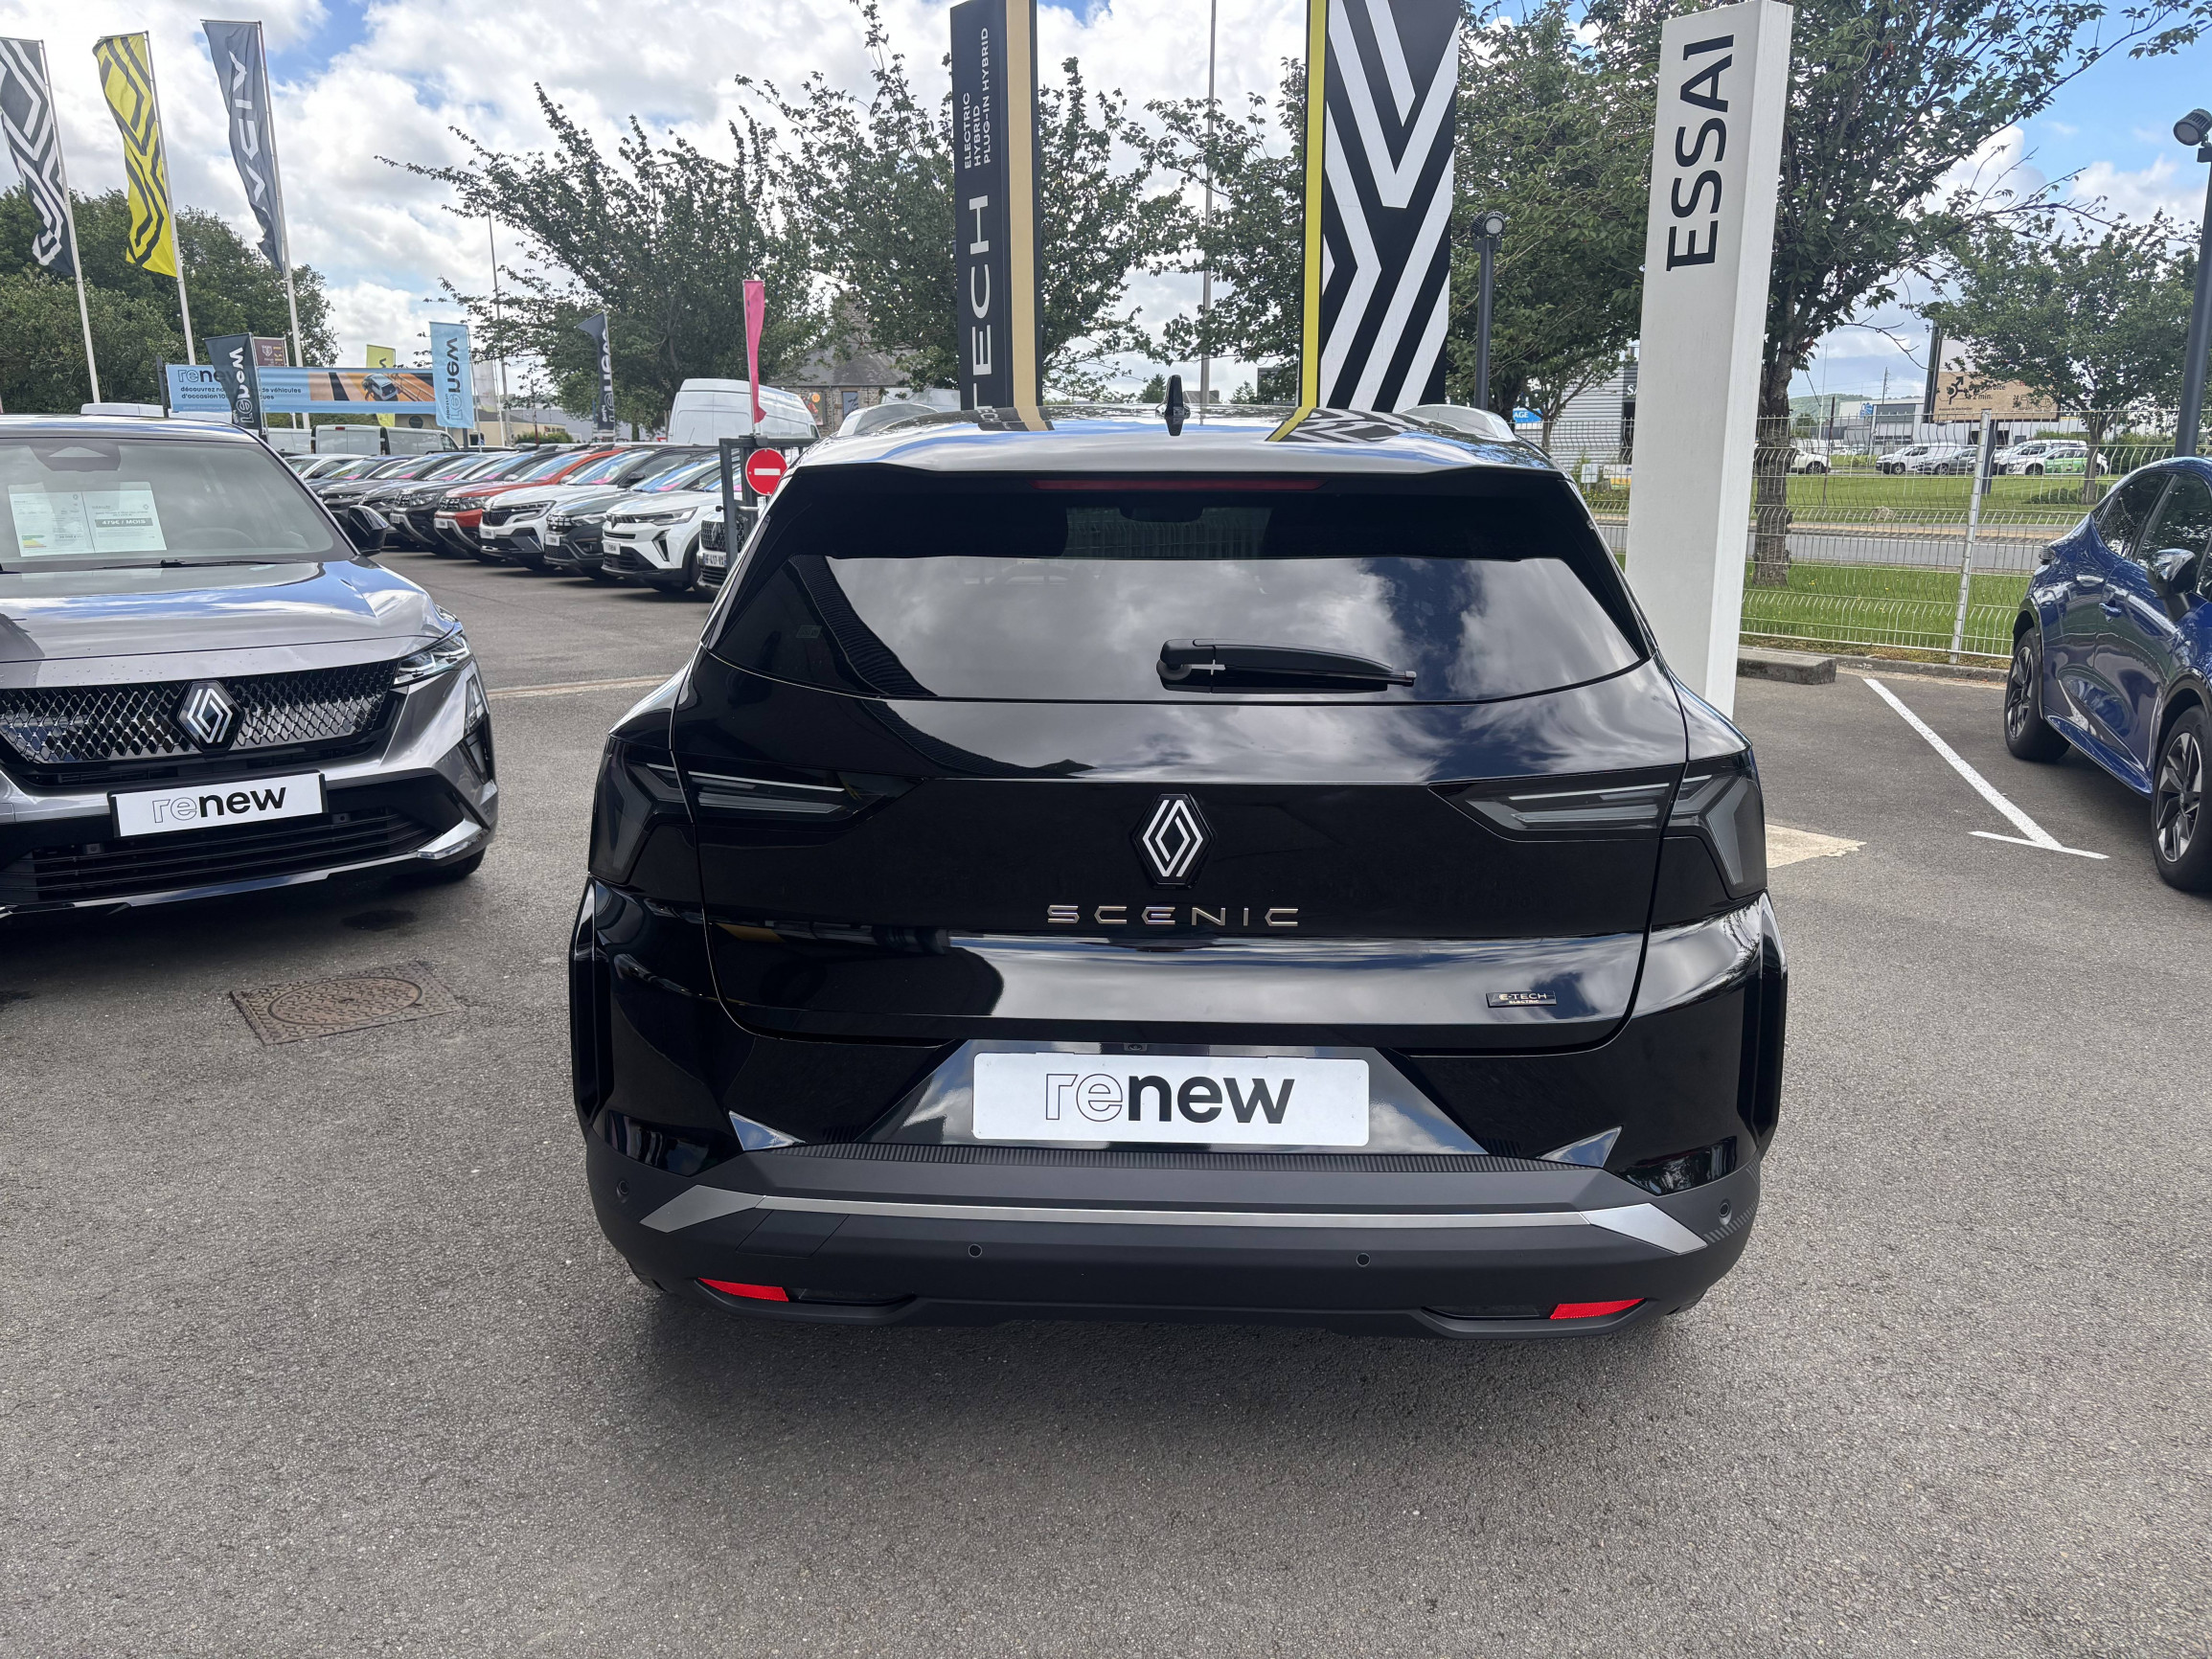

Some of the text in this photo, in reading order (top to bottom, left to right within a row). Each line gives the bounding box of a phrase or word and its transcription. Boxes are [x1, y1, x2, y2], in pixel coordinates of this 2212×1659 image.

[981, 27, 992, 164] PLUG-IN HYBRID
[963, 92, 971, 170] ELECTRIC
[972, 104, 981, 167] HYBRID
[1666, 34, 1735, 272] ESSAI
[152, 786, 286, 824] renew
[1047, 904, 1299, 927] SCENIC
[1046, 1073, 1296, 1125] renew
